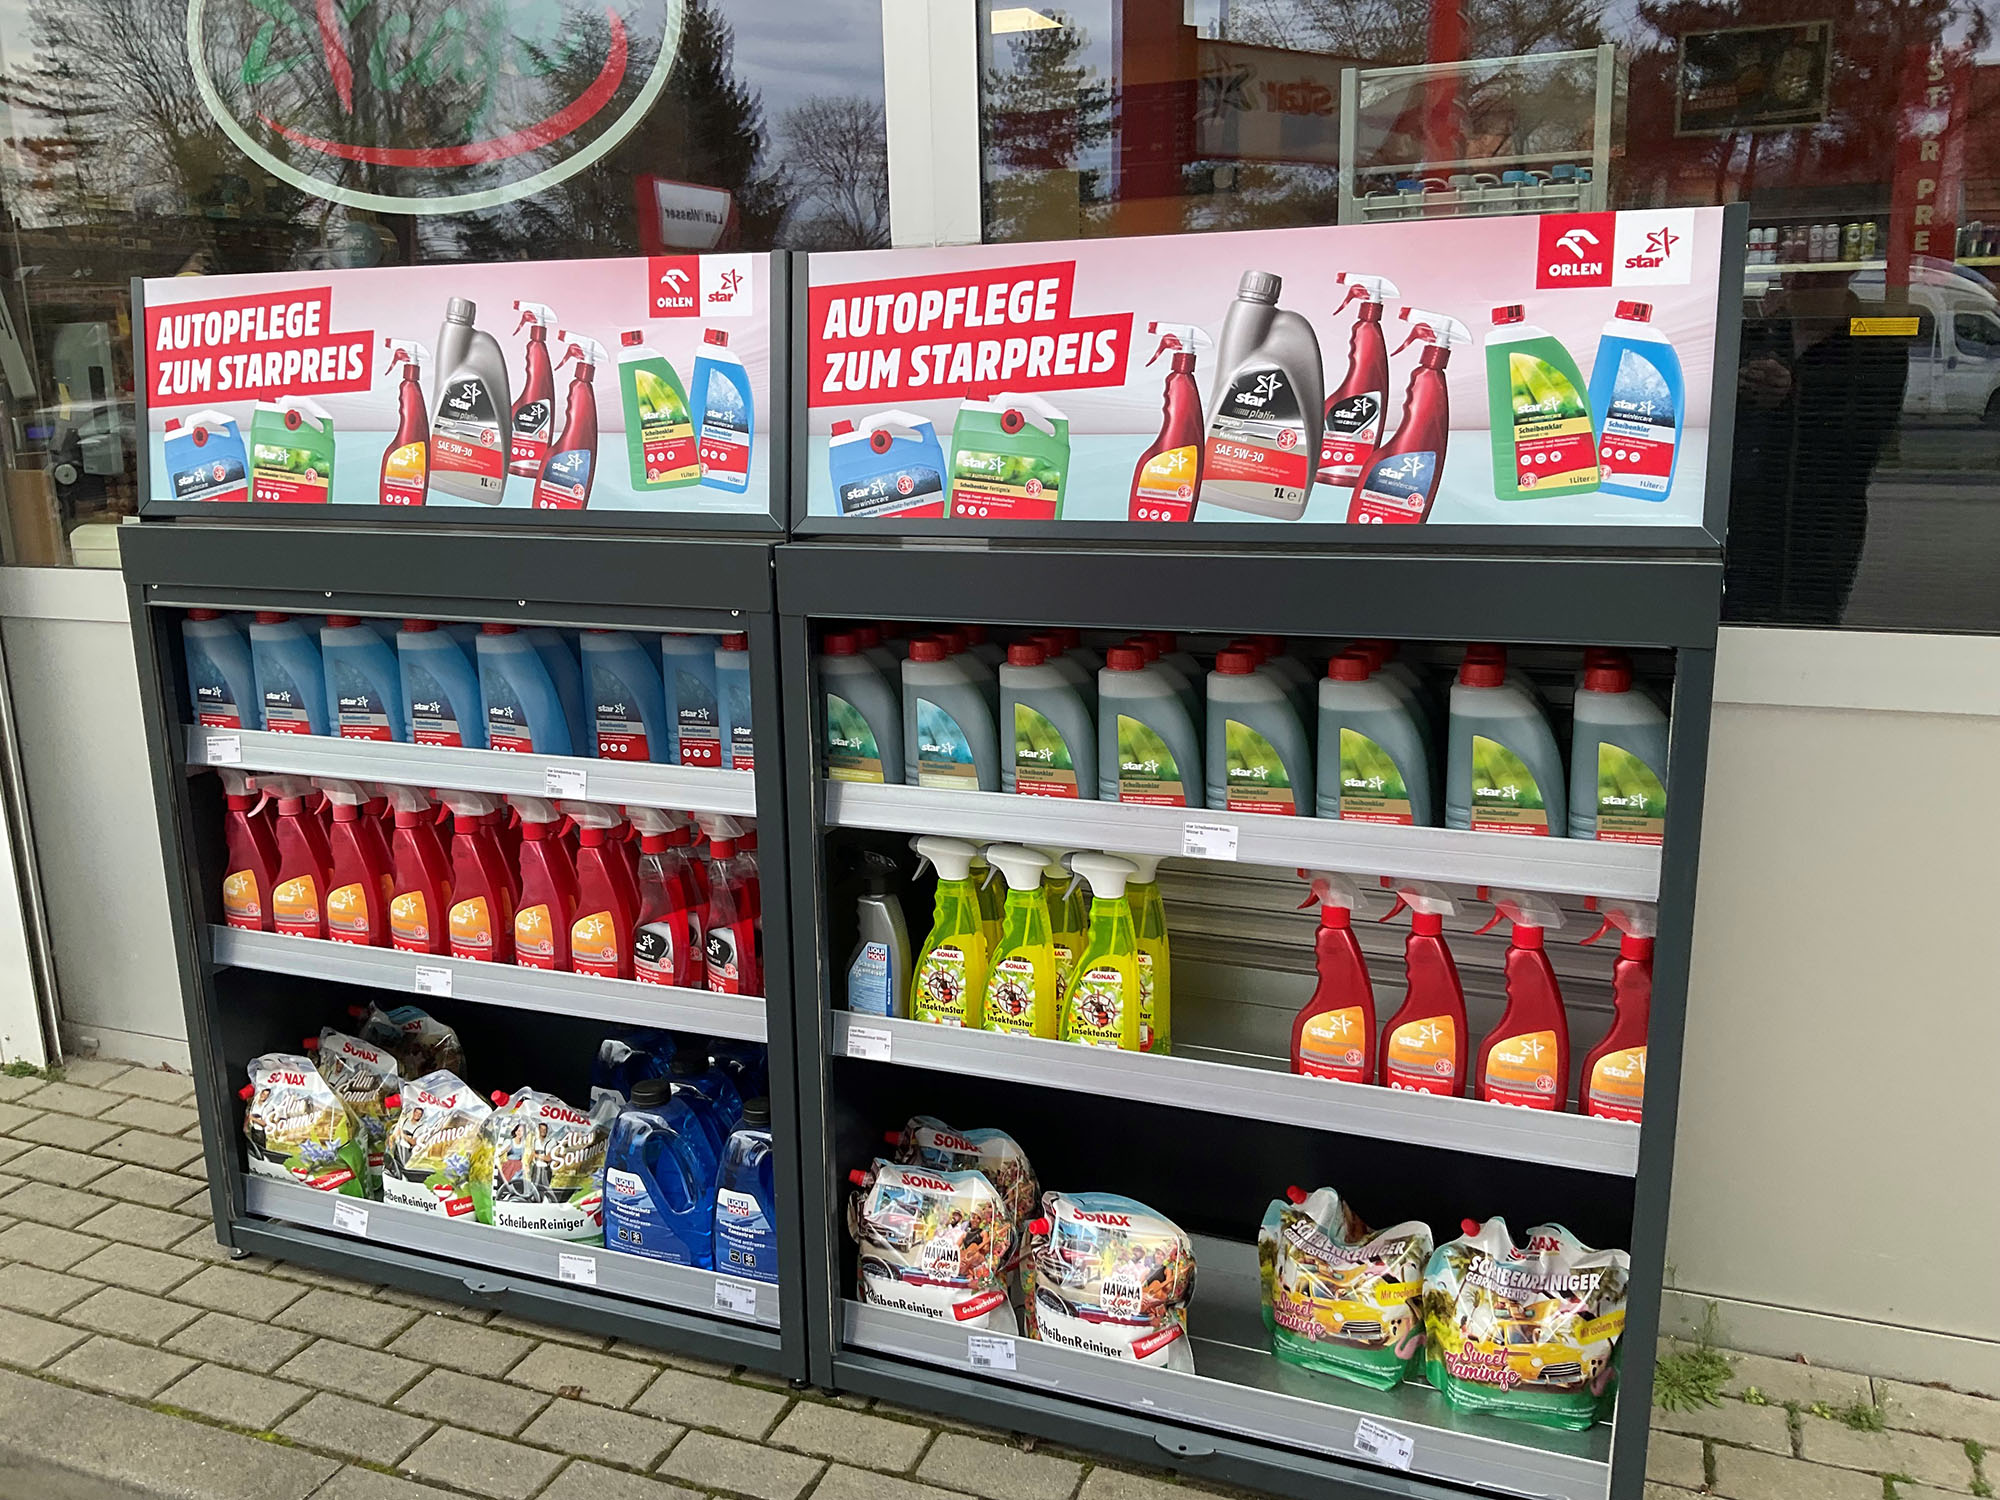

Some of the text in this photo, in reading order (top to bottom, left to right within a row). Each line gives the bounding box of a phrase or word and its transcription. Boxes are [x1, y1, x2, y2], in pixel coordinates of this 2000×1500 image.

[1625, 253, 1664, 269] star
[1548, 262, 1602, 277] ORLEN
[657, 297, 693, 309] ORLEN
[707, 290, 734, 303] star
[822, 277, 1060, 340] AUTOPFLEGE
[156, 299, 321, 351] AUTOPFLEGE
[822, 329, 1118, 393] ZUM STARPREIS
[158, 343, 365, 395] ZUM STARPREIS
[449, 397, 472, 411] star
[1235, 392, 1266, 408] star
[1613, 400, 1635, 411] star
[1334, 409, 1357, 420] star
[1517, 402, 1541, 414] star
[706, 409, 724, 421] star
[1249, 410, 1275, 421] platin
[1622, 413, 1653, 423] wintercare
[1518, 422, 1563, 434] Scheibenklar
[1608, 420, 1650, 433] Scheibenklar
[437, 439, 473, 457] SAE 5W-30
[1215, 443, 1264, 463] SAE 5W-30
[962, 457, 987, 470] star
[1379, 467, 1405, 480] star
[480, 477, 489, 487] 1L
[847, 486, 870, 501] star
[1273, 487, 1284, 499] 1L
[860, 495, 890, 508] wintercare
[490, 706, 505, 716] star
[597, 704, 614, 713] star
[680, 709, 697, 718] star
[733, 726, 752, 735] star
[831, 737, 850, 747] star
[921, 743, 940, 752] star
[1018, 749, 1039, 758] star
[1121, 761, 1144, 771] star
[1230, 767, 1252, 777] star
[1344, 777, 1368, 788] star
[1476, 786, 1501, 797] star
[1602, 795, 1629, 806] star
[867, 953, 886, 961] MOLY
[937, 951, 958, 959] SONAX
[1005, 962, 1027, 971] SONAX
[1091, 973, 1115, 981] SONAX
[919, 1001, 965, 1015] InsektenStar
[987, 1014, 1034, 1028] InsektenStar
[1071, 1026, 1122, 1039] InsektenStar
[1310, 1026, 1336, 1039] star
[1398, 1036, 1425, 1048] star
[1498, 1051, 1527, 1064] star
[1602, 1065, 1632, 1079] star
[267, 1071, 306, 1087] SONAX
[540, 1104, 591, 1126] SONAX
[263, 1109, 323, 1135] Sommer
[933, 1133, 983, 1153] SONAX
[615, 1176, 635, 1187] LIQUI
[902, 1174, 955, 1192] SONAX
[615, 1185, 636, 1197] MOLY
[727, 1197, 749, 1209] LIQUI
[727, 1206, 749, 1217] MOLY
[1073, 1208, 1131, 1227] SONAX
[499, 1213, 584, 1232] ScheibenReiniger
[1291, 1218, 1407, 1264] SCHEIBENREINIGER
[924, 1246, 959, 1263] HAVANA
[928, 1257, 951, 1270] Love
[1468, 1254, 1601, 1292] SCHIBENREINIGER
[1103, 1281, 1141, 1301] HAVANA
[1108, 1297, 1132, 1308] Love
[1279, 1291, 1314, 1318] Sweet
[1037, 1316, 1122, 1357] ScheibenReiniger
[1458, 1340, 1509, 1366] Sweet
[1444, 1350, 1521, 1393] Flamingo
